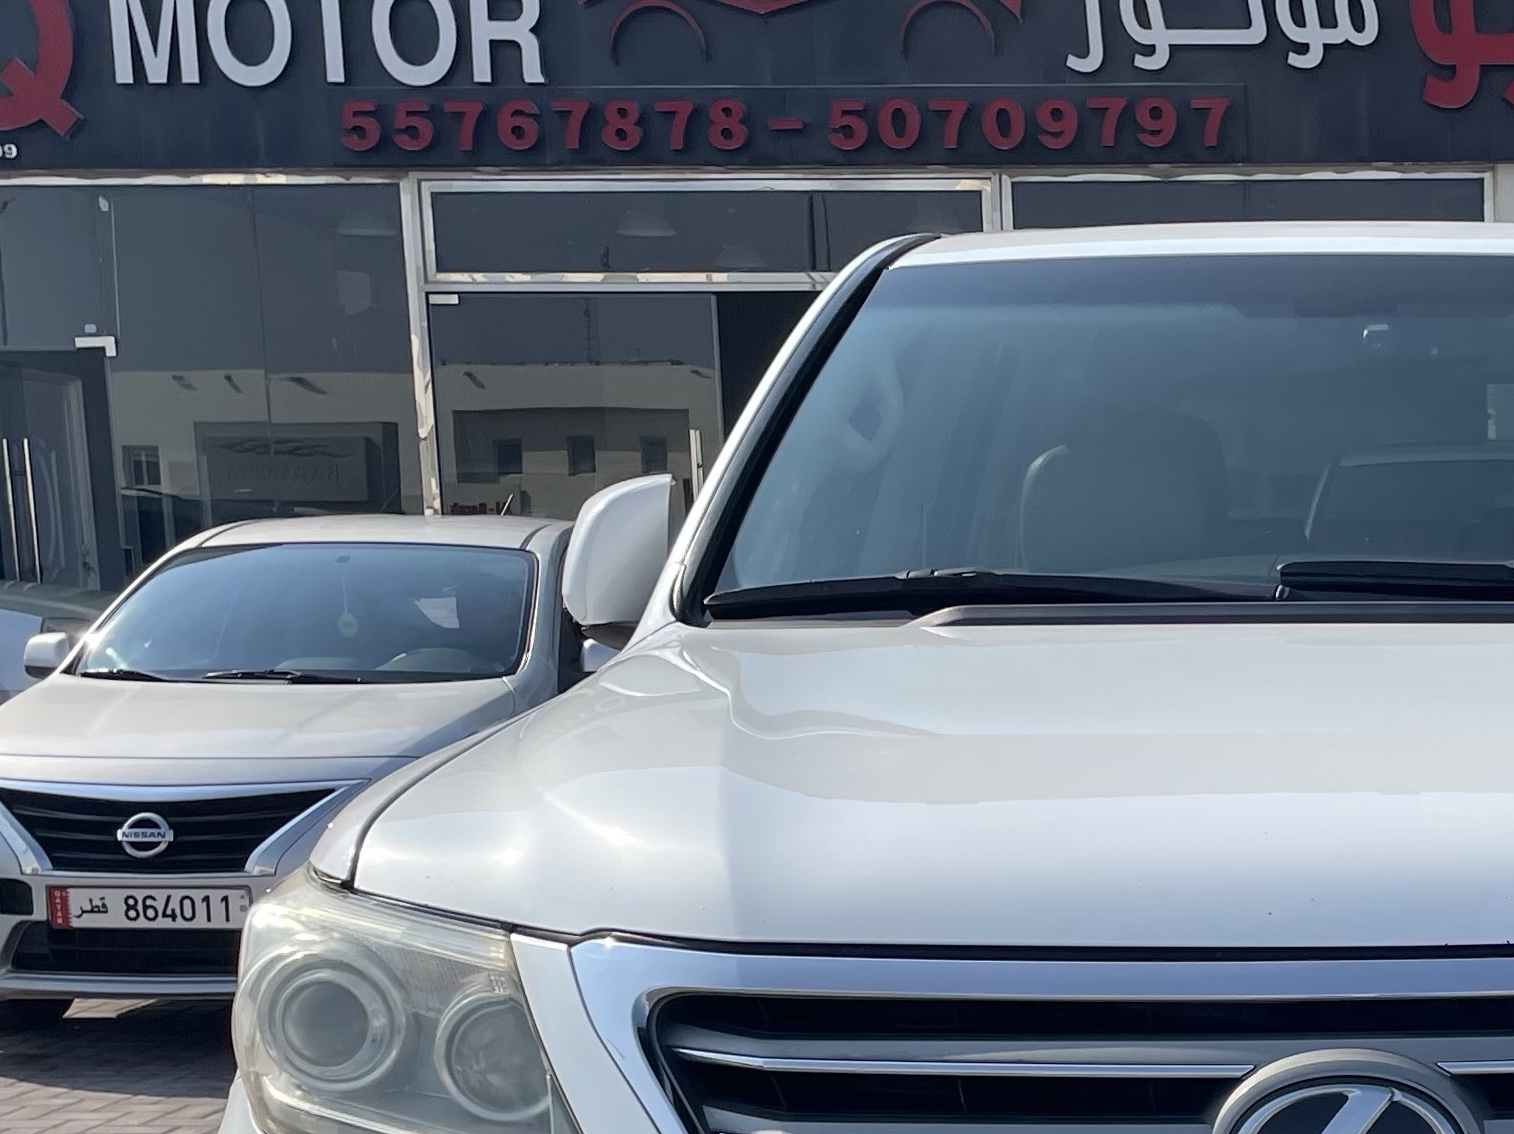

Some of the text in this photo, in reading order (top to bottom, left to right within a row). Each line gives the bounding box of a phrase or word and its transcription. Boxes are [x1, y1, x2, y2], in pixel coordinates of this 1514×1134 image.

[121, 831, 167, 839] NISSAN
[73, 897, 109, 918] قطر
[123, 895, 231, 922] 864011
